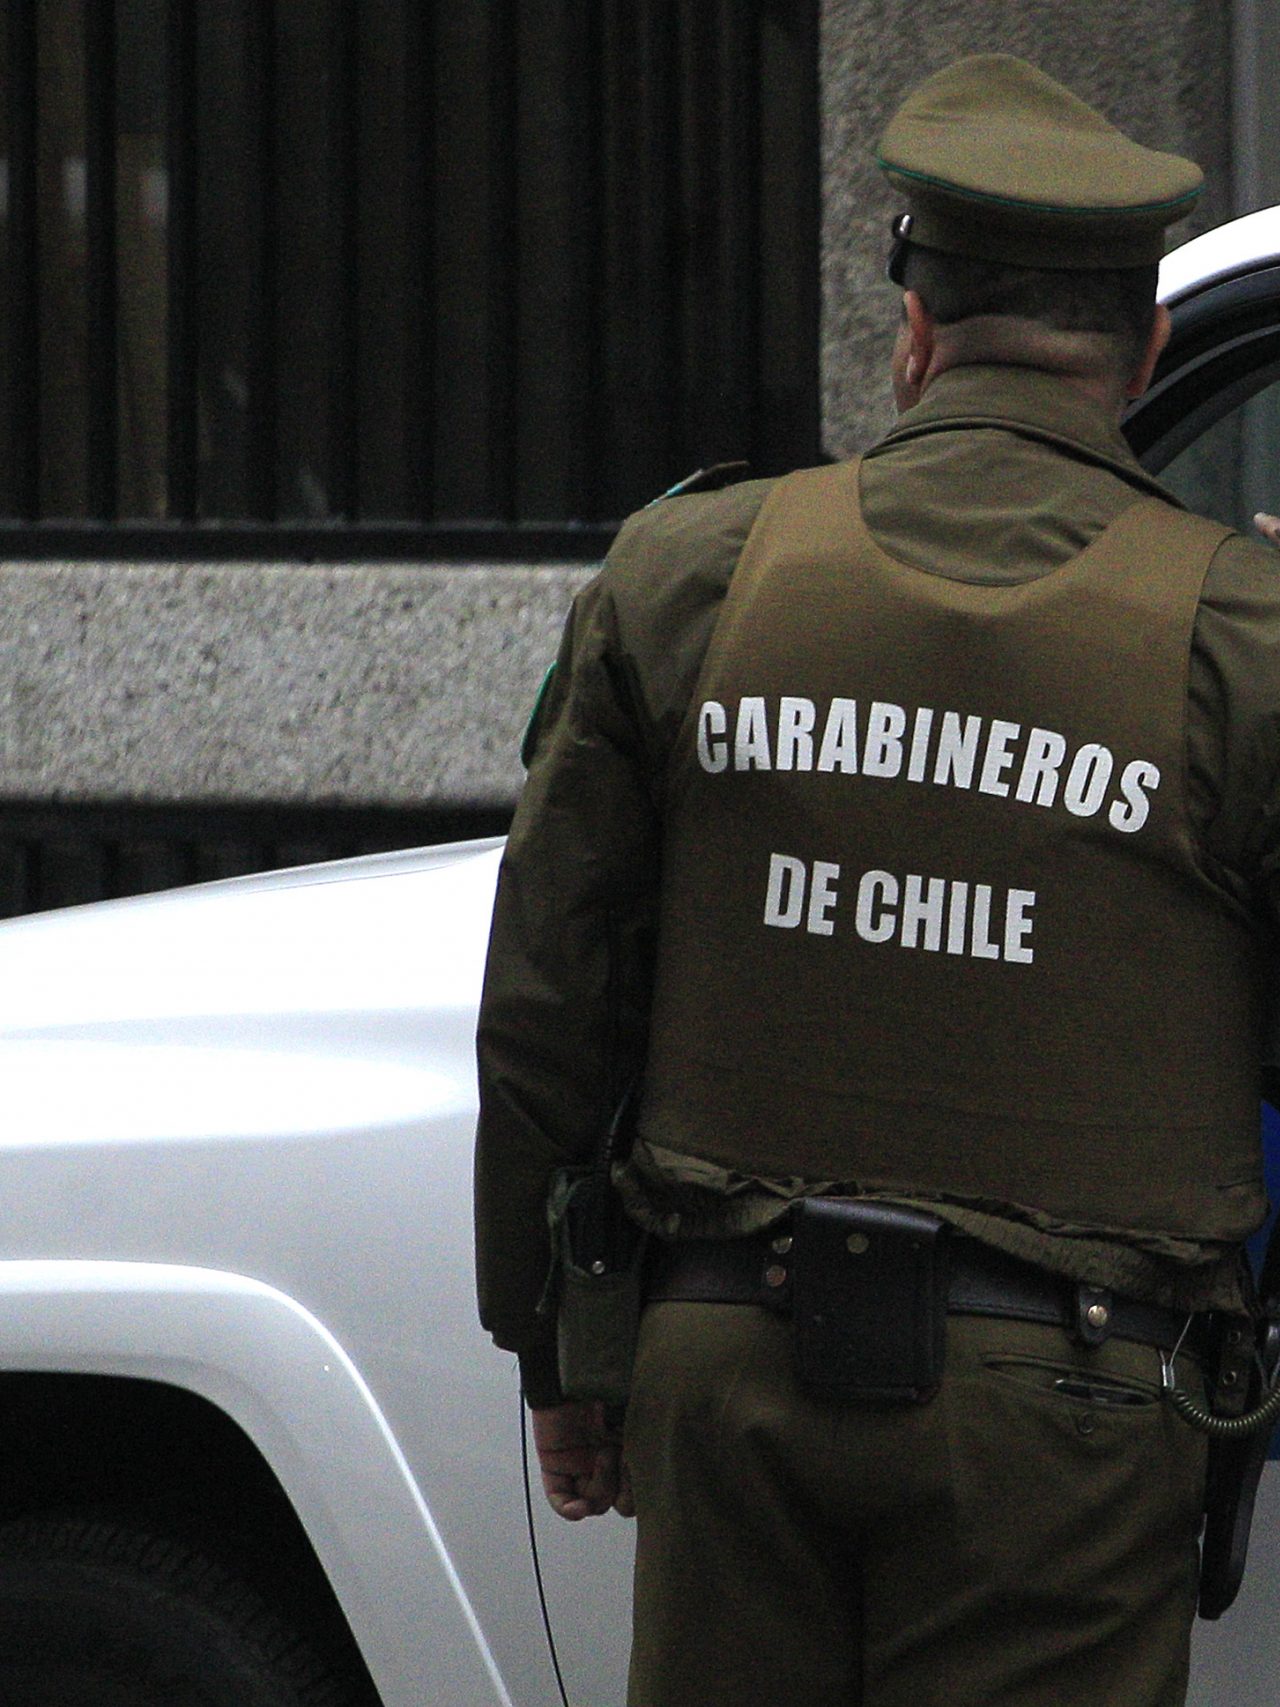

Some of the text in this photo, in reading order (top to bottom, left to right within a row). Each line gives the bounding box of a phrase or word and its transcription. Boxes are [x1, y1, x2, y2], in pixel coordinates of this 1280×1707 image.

[697, 696, 1160, 833] CARABINEROS
[764, 852, 1036, 964] DE CHILE
